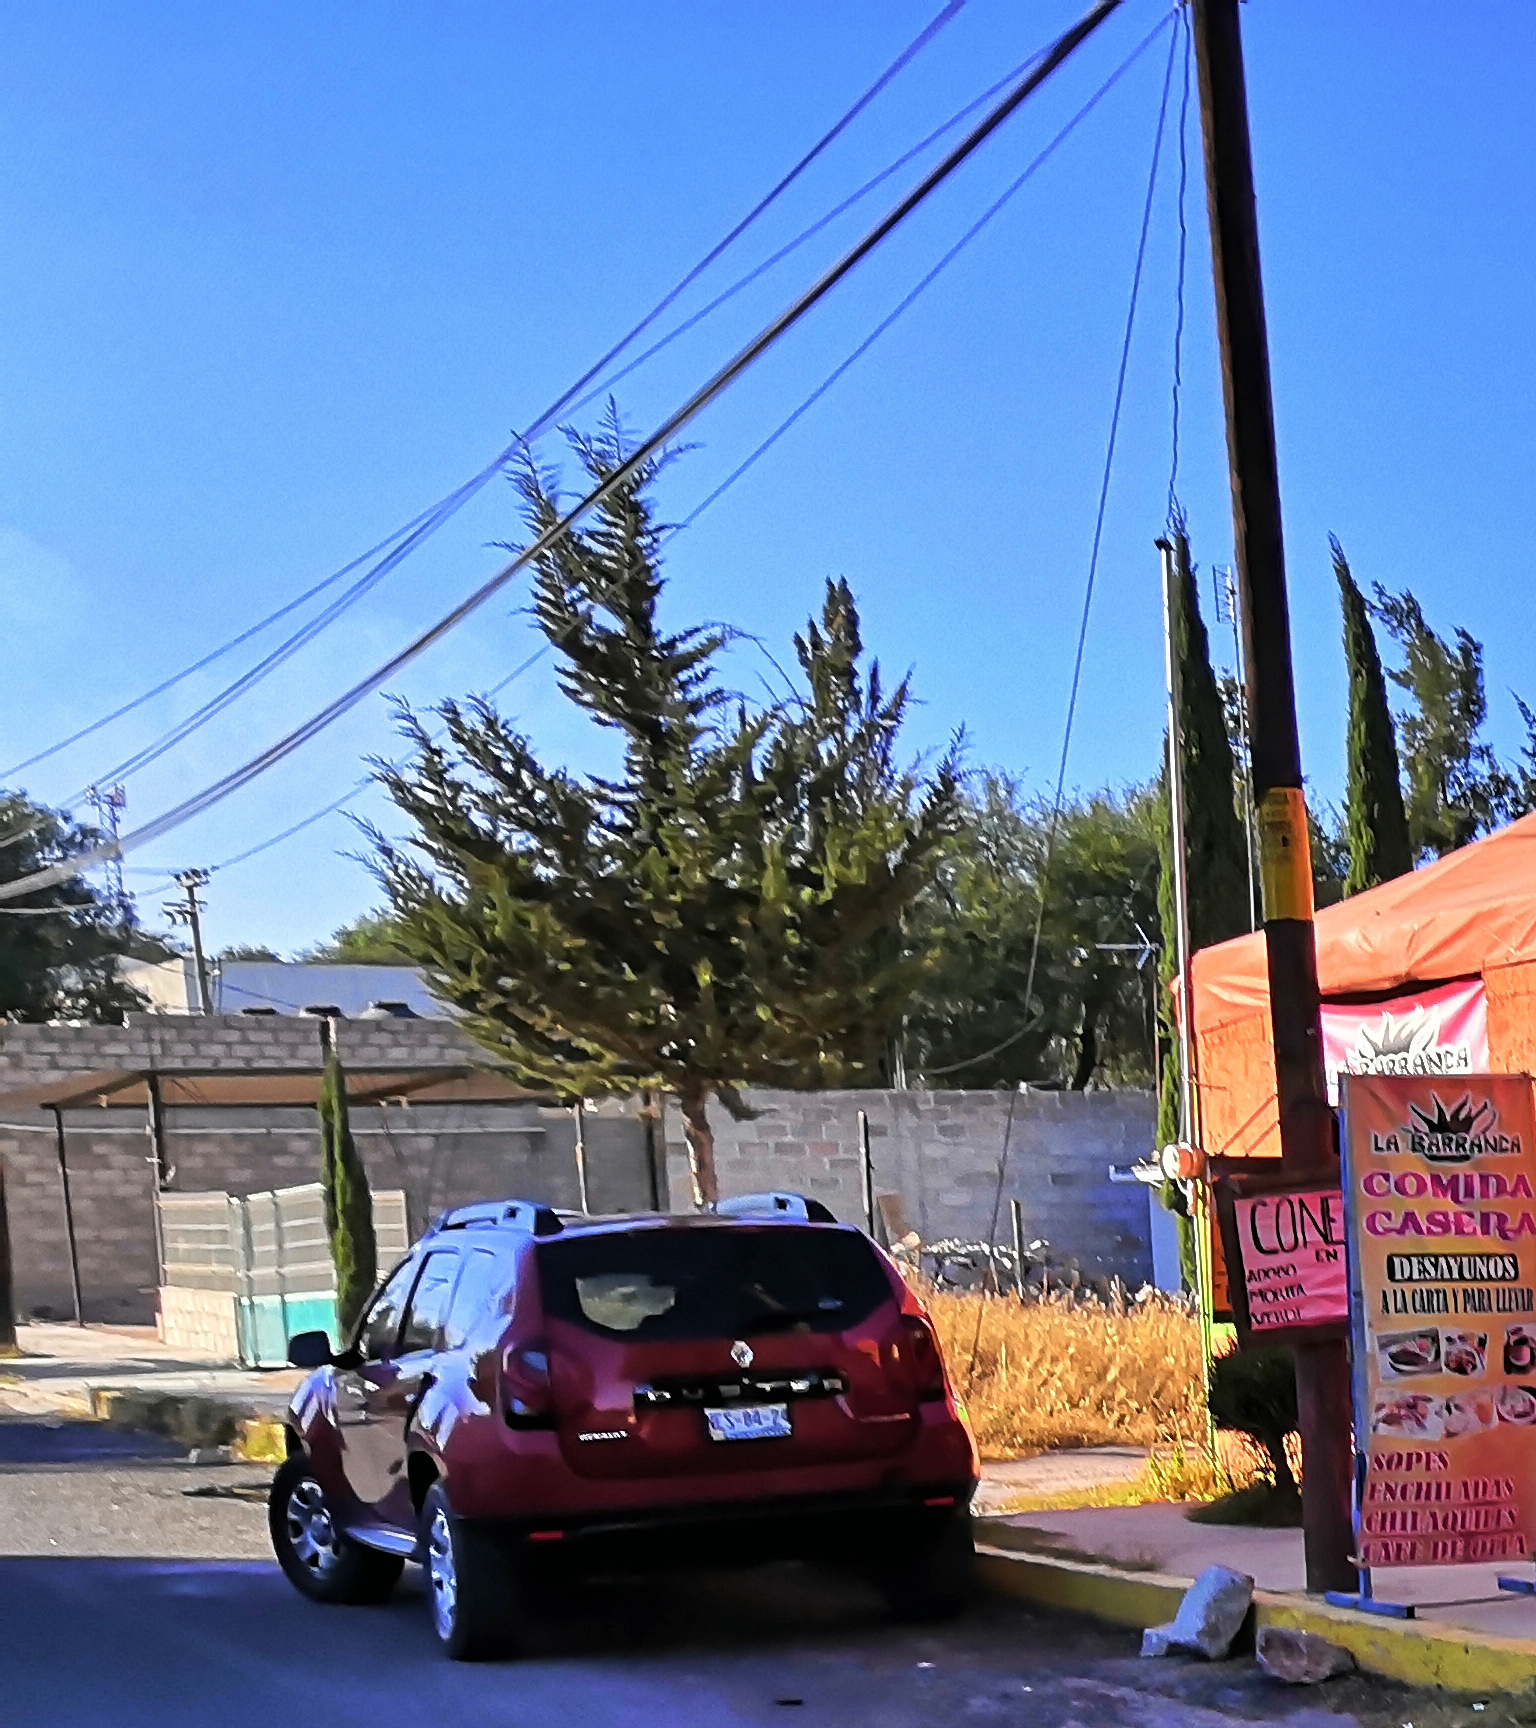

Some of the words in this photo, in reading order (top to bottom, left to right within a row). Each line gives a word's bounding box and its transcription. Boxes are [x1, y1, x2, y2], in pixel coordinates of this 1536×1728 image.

[1373, 1132, 1400, 1153] LA
[1411, 1132, 1521, 1153] BARRANCA
[1362, 1171, 1533, 1204] COMIDA
[1393, 1255, 1517, 1281] DESAYUNOS
[1382, 1288, 1390, 1315] A
[1393, 1288, 1409, 1315] LA
[1411, 1288, 1449, 1314] CARTA
[1452, 1288, 1460, 1314] Y
[1463, 1288, 1493, 1314] PARA
[1495, 1287, 1535, 1314] LLEVAR
[1372, 1451, 1449, 1473] SOPES
[1368, 1476, 1515, 1502] ENCHILADAS
[1363, 1507, 1519, 1534] CHILAQUILES
